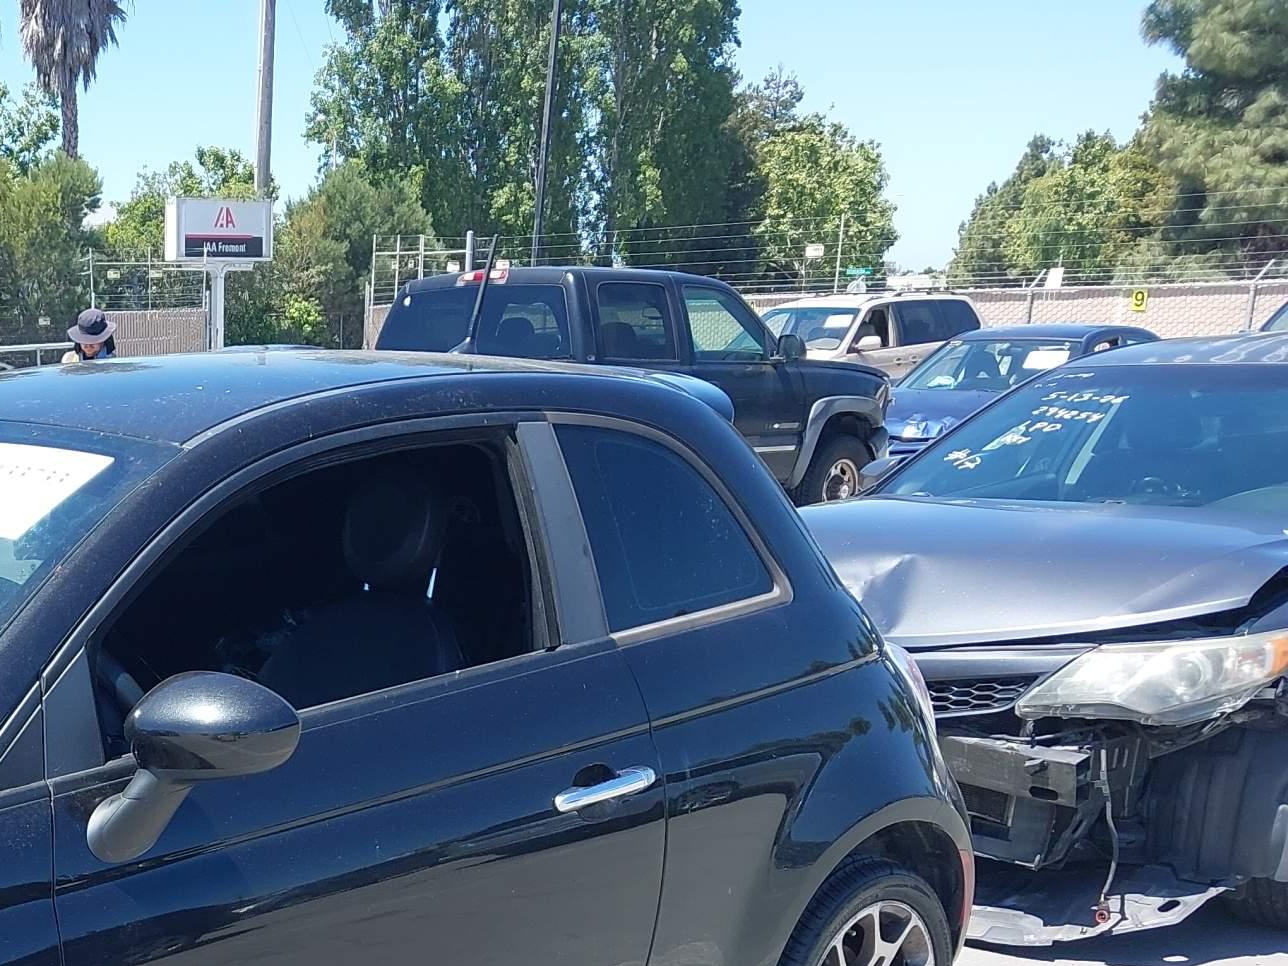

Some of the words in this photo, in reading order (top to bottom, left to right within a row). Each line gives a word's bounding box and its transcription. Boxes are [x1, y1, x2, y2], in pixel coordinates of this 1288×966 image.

[204, 241, 217, 253] IAA
[218, 241, 247, 253] Fremont
[1134, 291, 1145, 307] 9
